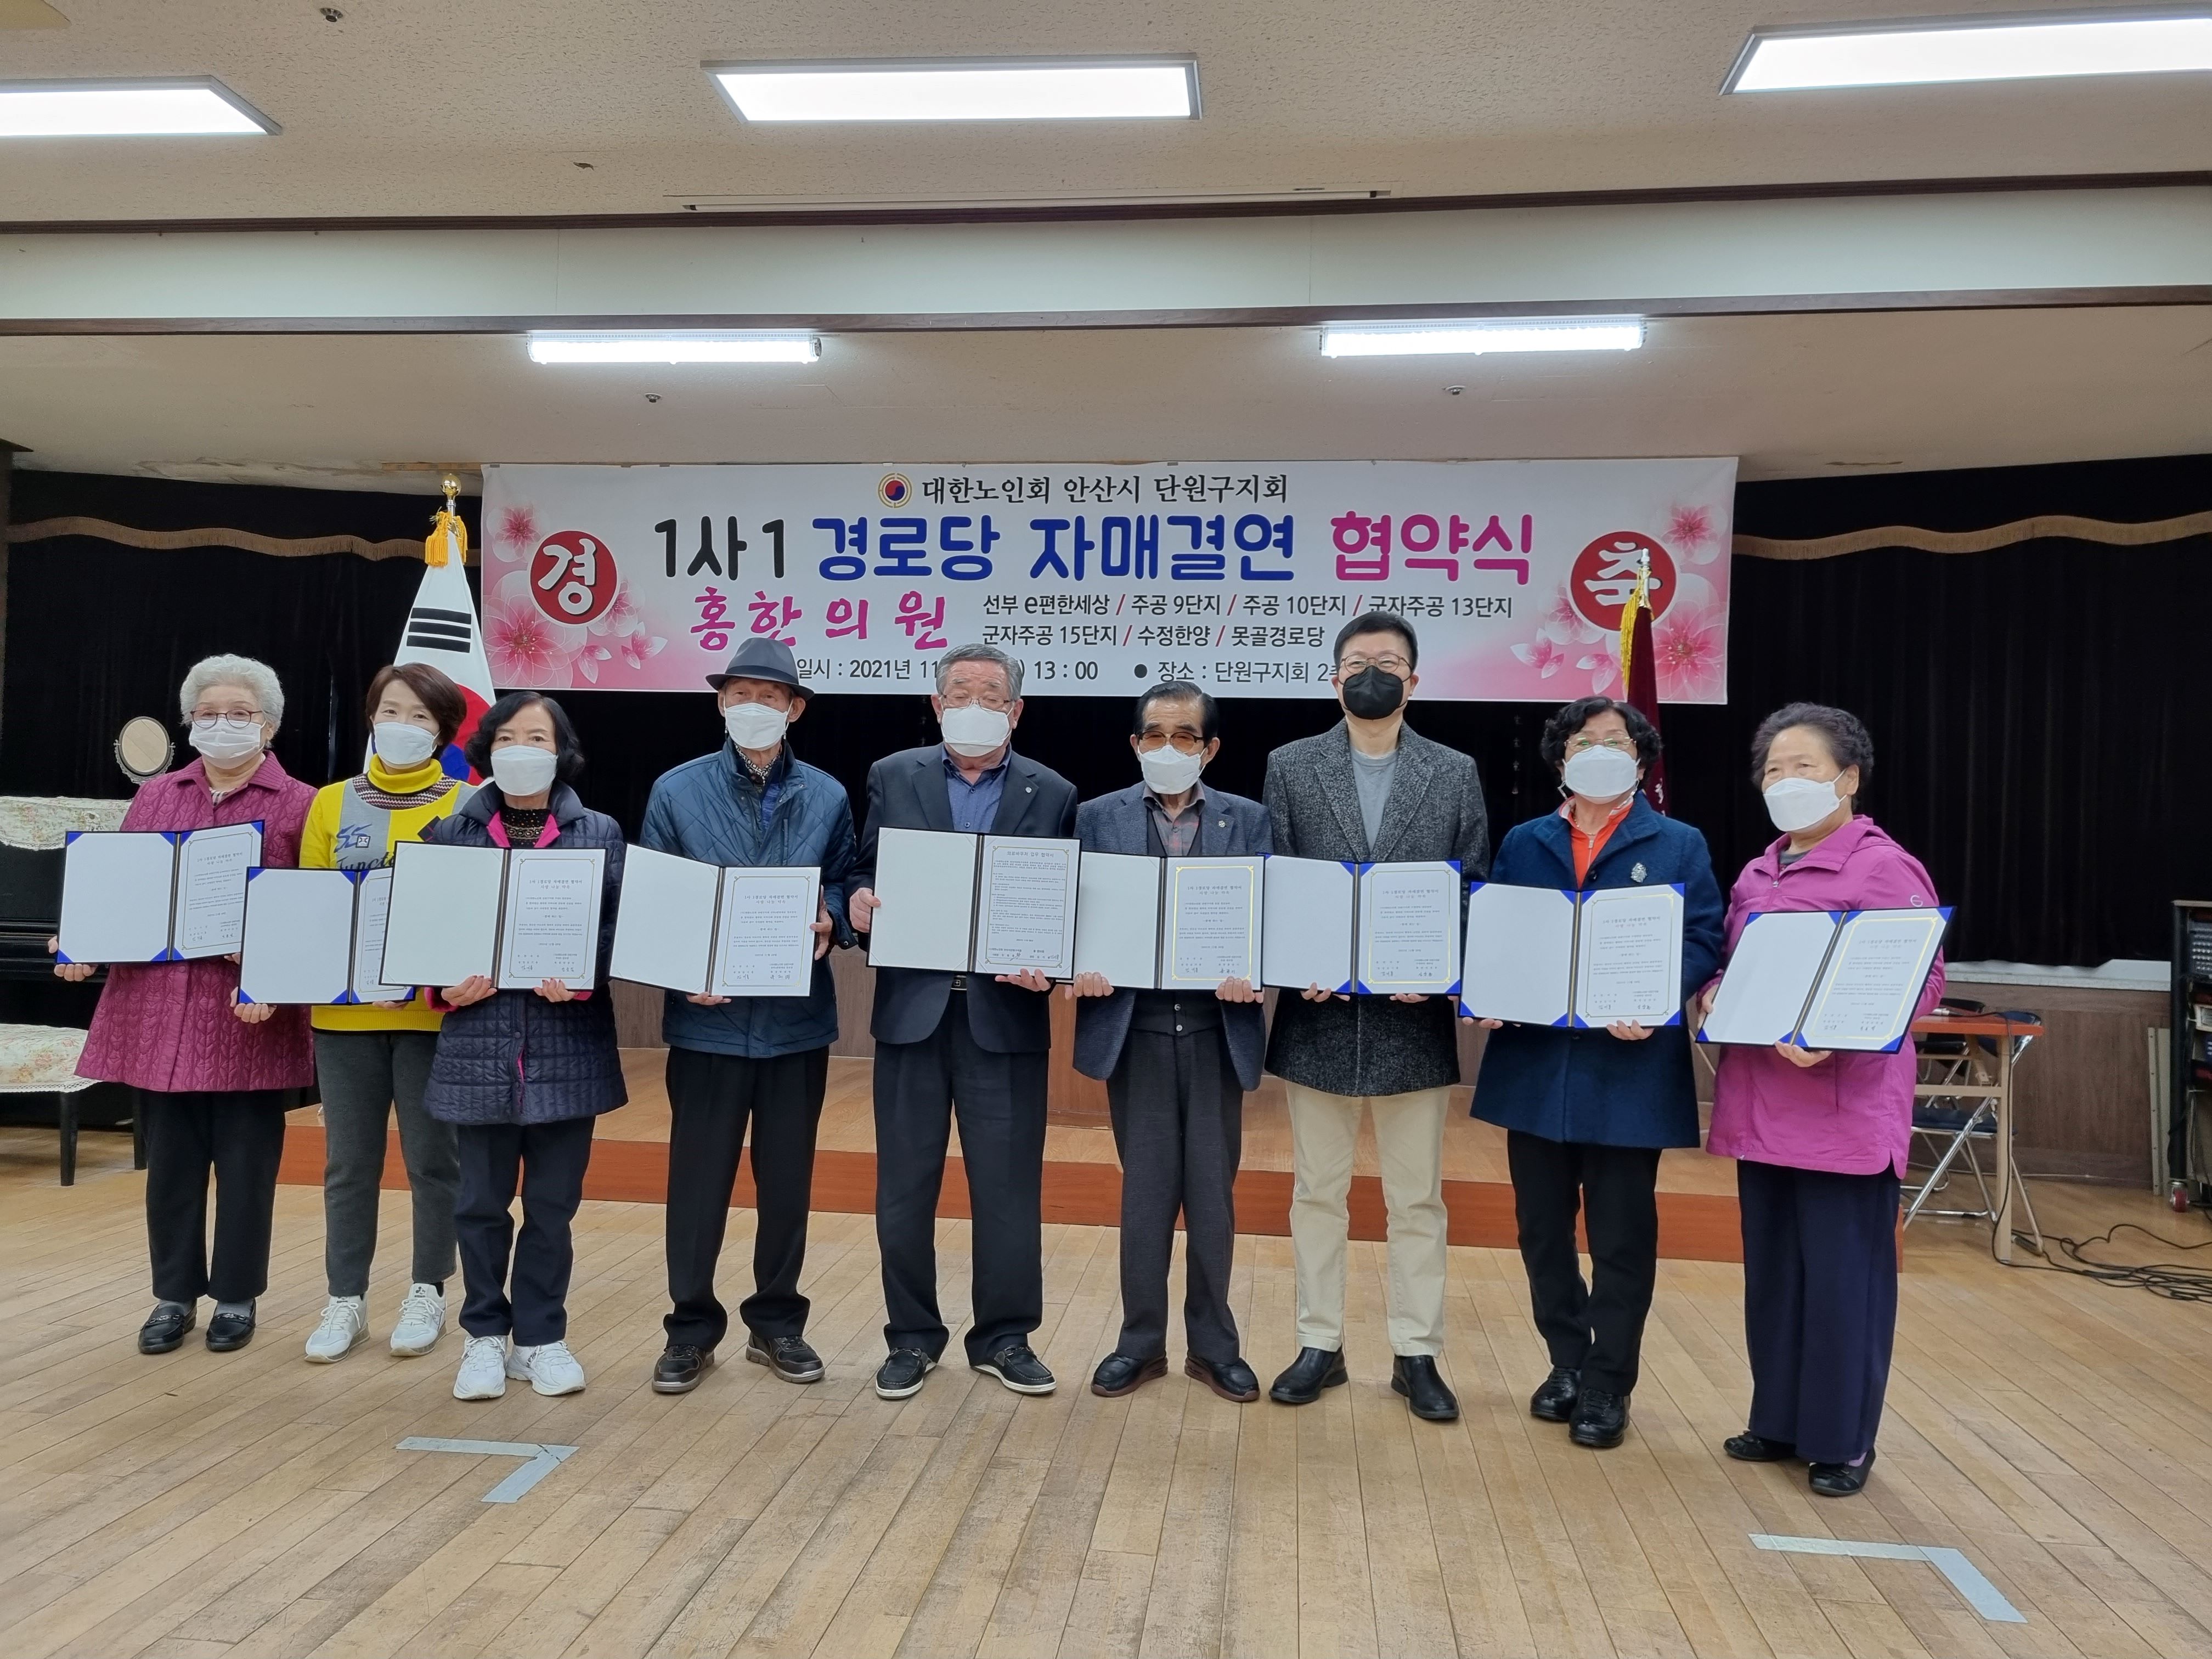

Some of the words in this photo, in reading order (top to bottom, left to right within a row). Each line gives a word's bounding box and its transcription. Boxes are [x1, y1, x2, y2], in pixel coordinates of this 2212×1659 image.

[922, 477, 1049, 505] 대한노인회
[1064, 476, 1139, 504] 안산시
[1154, 475, 1287, 504] 단원구지회
[812, 516, 1001, 582] 경로당
[1030, 514, 1295, 582] 자매결연
[1330, 510, 1533, 585] 협약식
[537, 538, 597, 616] 경
[984, 595, 1018, 615] 선부
[1025, 595, 1110, 615] e편한세상
[1132, 595, 1167, 615] 주공
[1173, 595, 1221, 615] 9단지
[1243, 596, 1279, 616] 주공
[1287, 595, 1346, 616] 10단지
[1369, 596, 1444, 617] 군자주공
[1452, 597, 1511, 618] 13단지
[982, 625, 1053, 646] 군자주공
[1060, 625, 1118, 646] 15단지
[1138, 626, 1210, 647] 수정한양
[1232, 627, 1325, 647] 못골경로당
[797, 659, 830, 680] 일시
[850, 659, 910, 680] 2021년
[1158, 662, 1194, 682] 장소
[1215, 662, 1308, 683] 단원구지회
